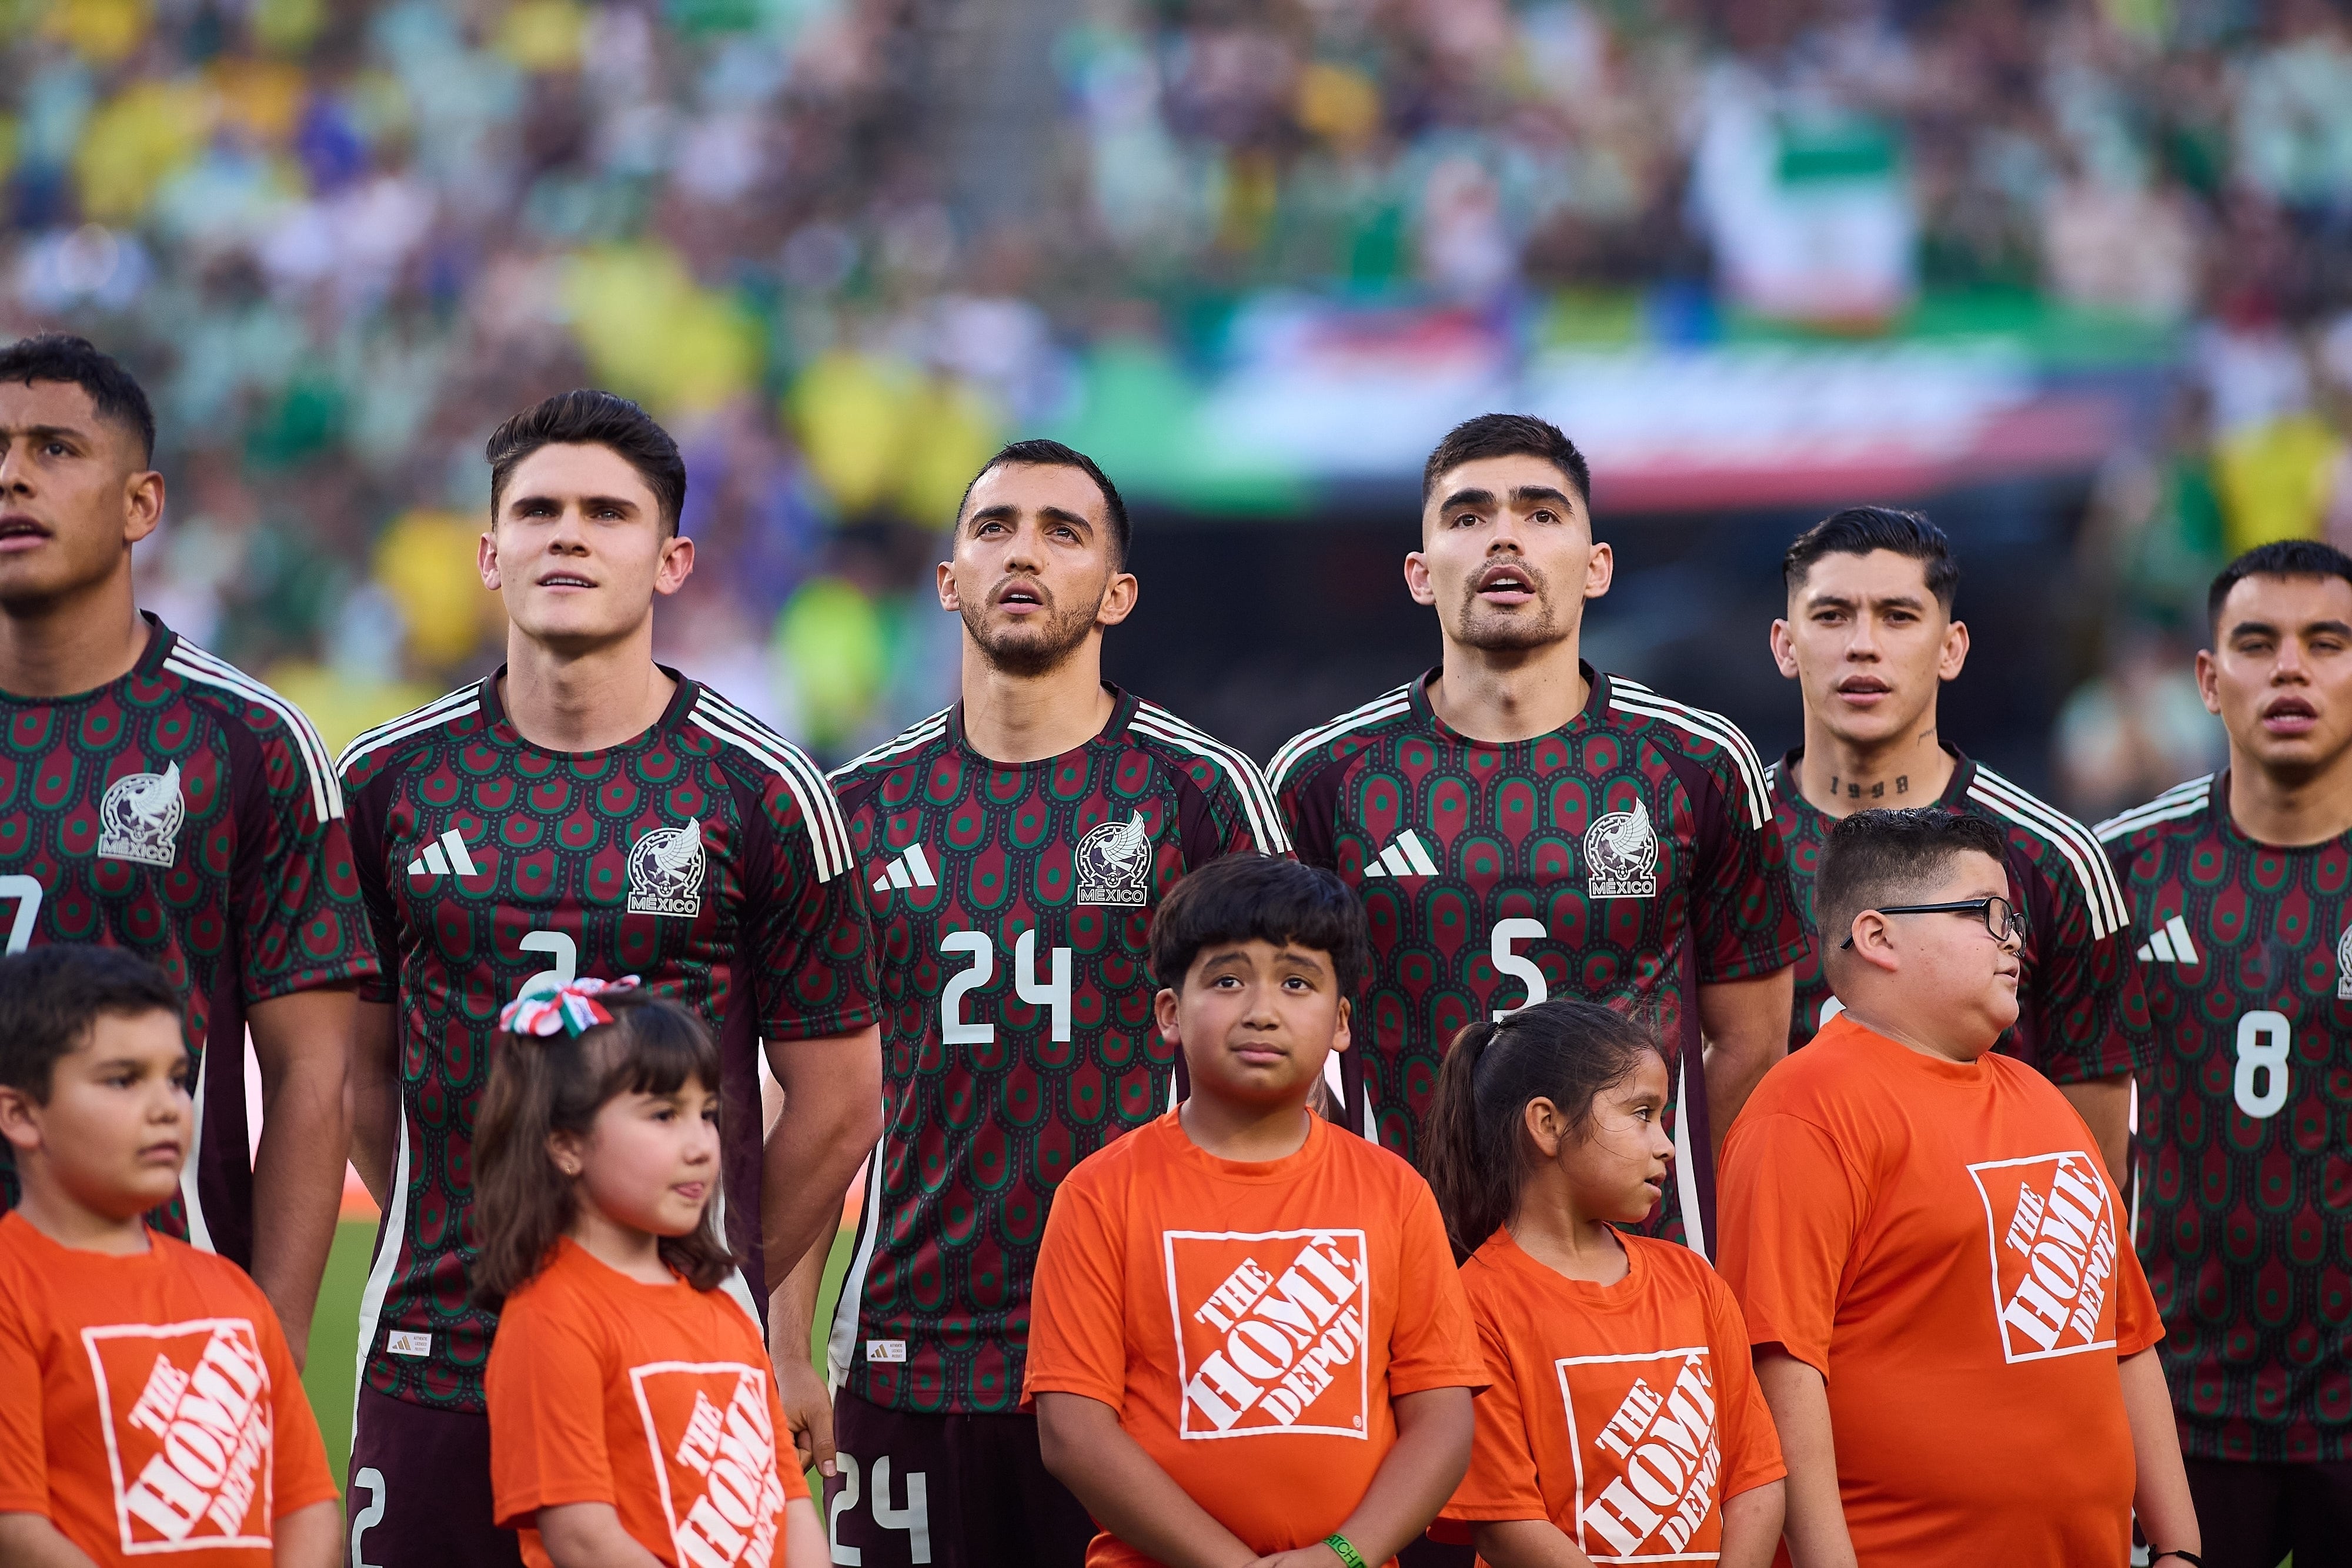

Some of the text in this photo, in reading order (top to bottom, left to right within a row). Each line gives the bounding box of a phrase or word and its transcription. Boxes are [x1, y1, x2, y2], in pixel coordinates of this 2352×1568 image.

[1830, 775, 1908, 800] 1998
[631, 893, 696, 914] MÉXICO
[1080, 885, 1144, 902] MÉXICO
[1592, 877, 1653, 895] MÉXICO
[940, 928, 1072, 1045] 24
[1491, 918, 1547, 1025] 5
[2234, 1010, 2291, 1118] 8
[2003, 1157, 2106, 1350] HOME
[2005, 1181, 2046, 1258] THE
[1187, 1235, 1363, 1431] HOME
[1193, 1256, 1275, 1334] THE
[2070, 1219, 2116, 1344] DEPOT
[127, 1352, 190, 1440] THE
[1258, 1304, 1364, 1426] DEPOT
[125, 1320, 270, 1541] HOME
[675, 1389, 724, 1477] THE
[1582, 1353, 1716, 1557] HOME
[1594, 1376, 1665, 1460] THE
[351, 1467, 386, 1568] 2
[742, 1464, 786, 1568] DEPO
[830, 1451, 931, 1567] 24
